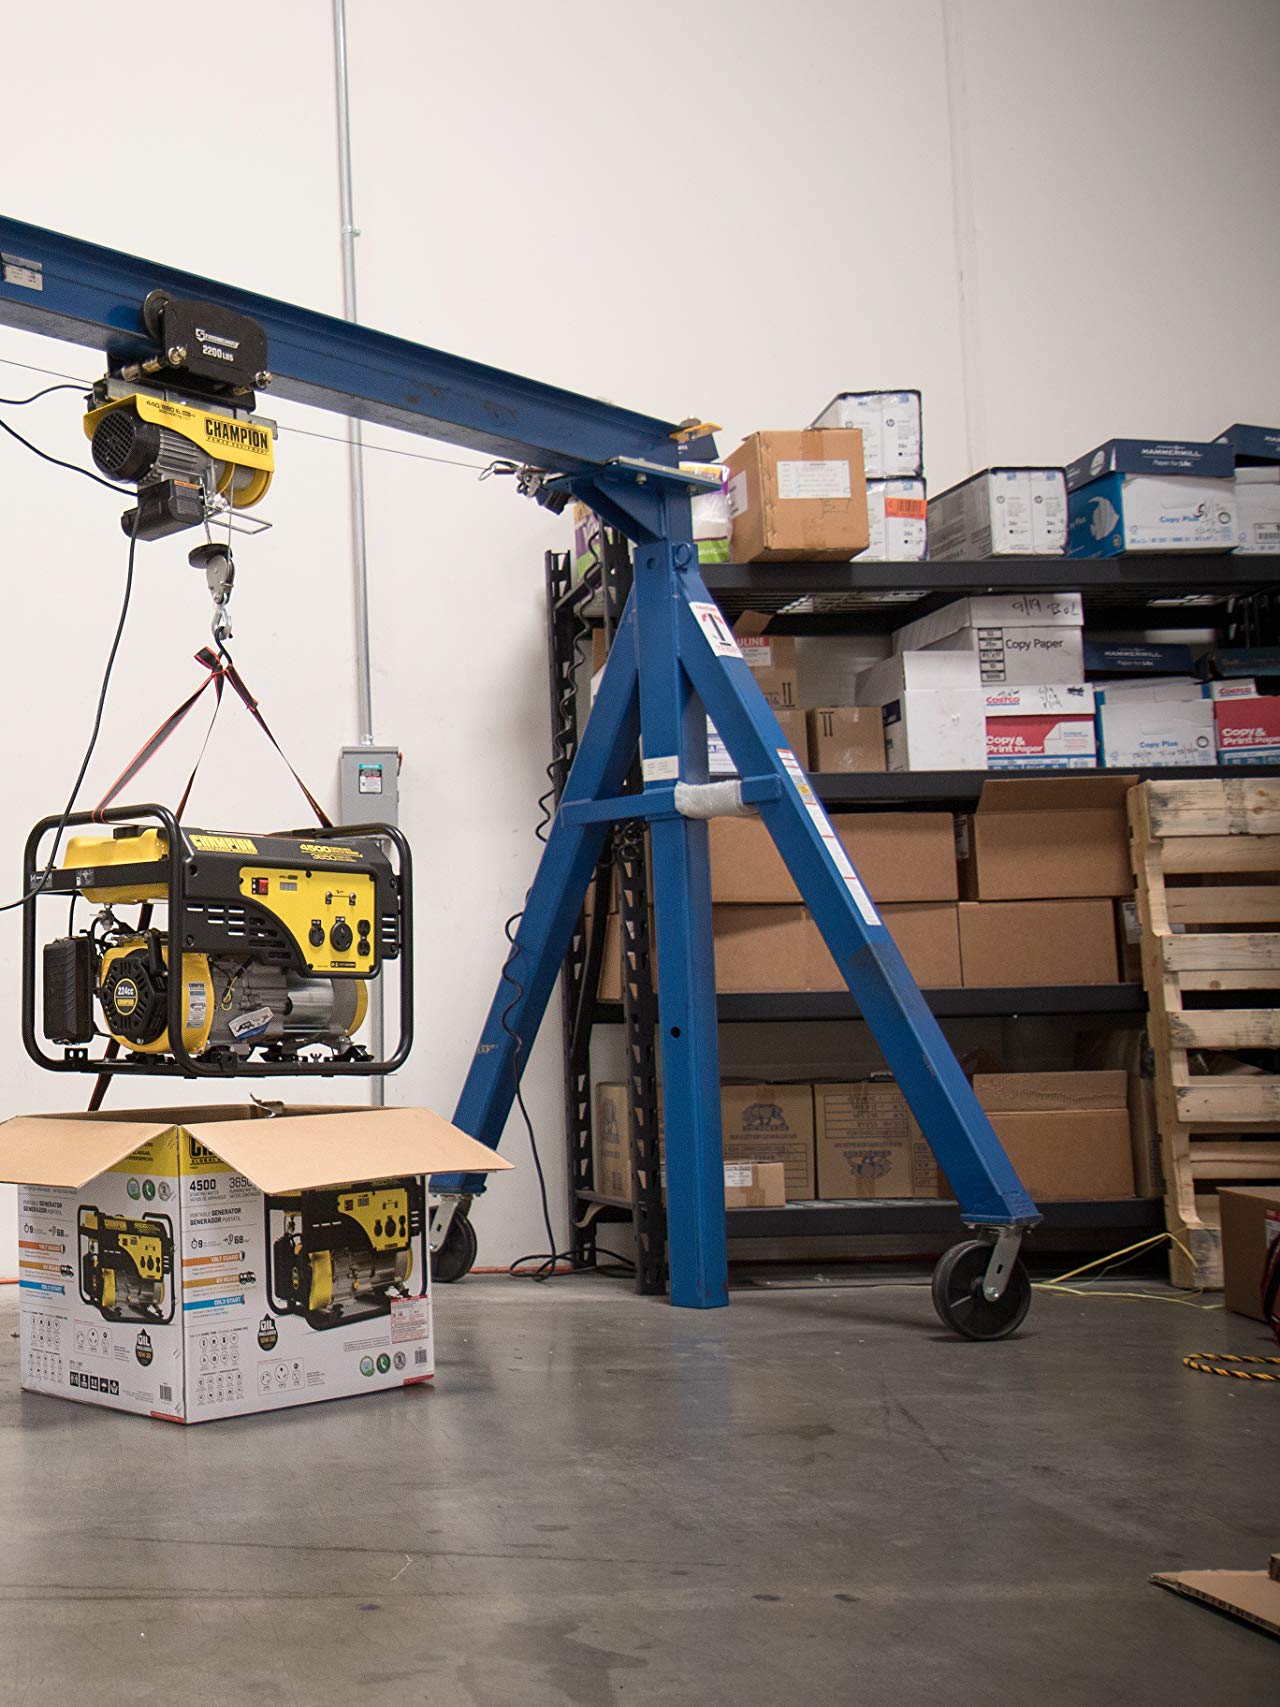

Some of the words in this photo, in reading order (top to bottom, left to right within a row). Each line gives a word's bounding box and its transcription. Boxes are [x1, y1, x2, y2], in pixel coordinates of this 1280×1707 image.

[202, 345, 223, 359] 2200
[205, 419, 269, 450] CHAMPION
[737, 637, 765, 647] ULINE
[1005, 639, 1031, 651] Copy
[1034, 639, 1064, 650] Paper
[986, 696, 1020, 704] COSTCO
[1222, 728, 1254, 740] Copy
[1254, 727, 1266, 737] &
[986, 735, 1015, 746] Copy
[1015, 736, 1025, 746] &
[1223, 736, 1254, 746] Print
[1256, 736, 1280, 745] Pape
[986, 745, 1013, 753] Print
[1015, 745, 1044, 755] Paper
[189, 834, 258, 852] CHAMPION
[117, 986, 134, 996] 224cc
[190, 1179, 217, 1191] 4500
[211, 1208, 242, 1217] GENERATOR
[190, 1216, 222, 1226] GENERADOR
